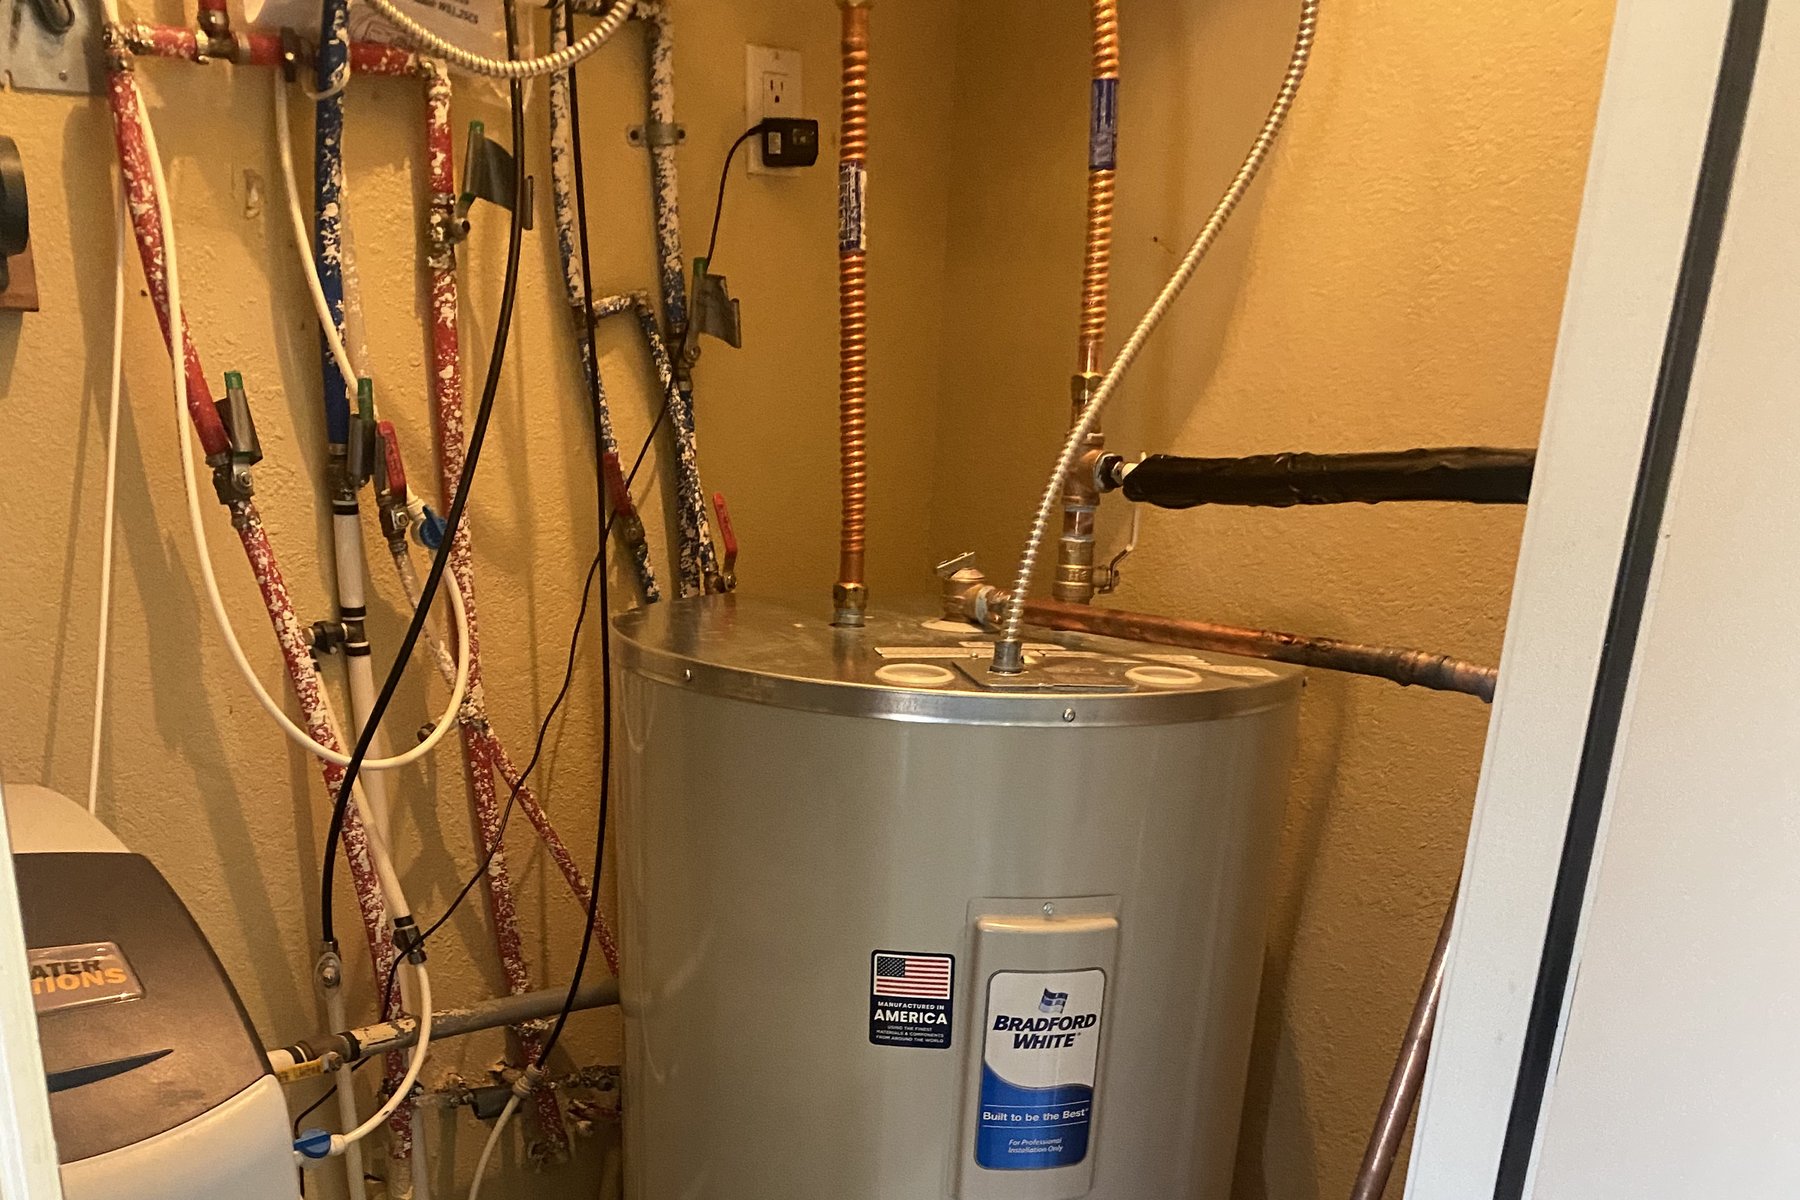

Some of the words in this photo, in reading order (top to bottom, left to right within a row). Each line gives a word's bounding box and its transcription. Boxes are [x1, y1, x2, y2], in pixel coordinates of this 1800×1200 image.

[877, 1001, 935, 1010] MANUFACTURED
[874, 1009, 948, 1024] AMERICA
[992, 1013, 1097, 1032] BRADFORD
[1013, 1032, 1076, 1049] WHITE
[983, 1111, 1008, 1120] Built
[1011, 1112, 1022, 1122] to
[1025, 1112, 1040, 1122] be
[1043, 1112, 1059, 1120] the
[1008, 1138, 1020, 1146] For
[1047, 1145, 1064, 1153] Only
